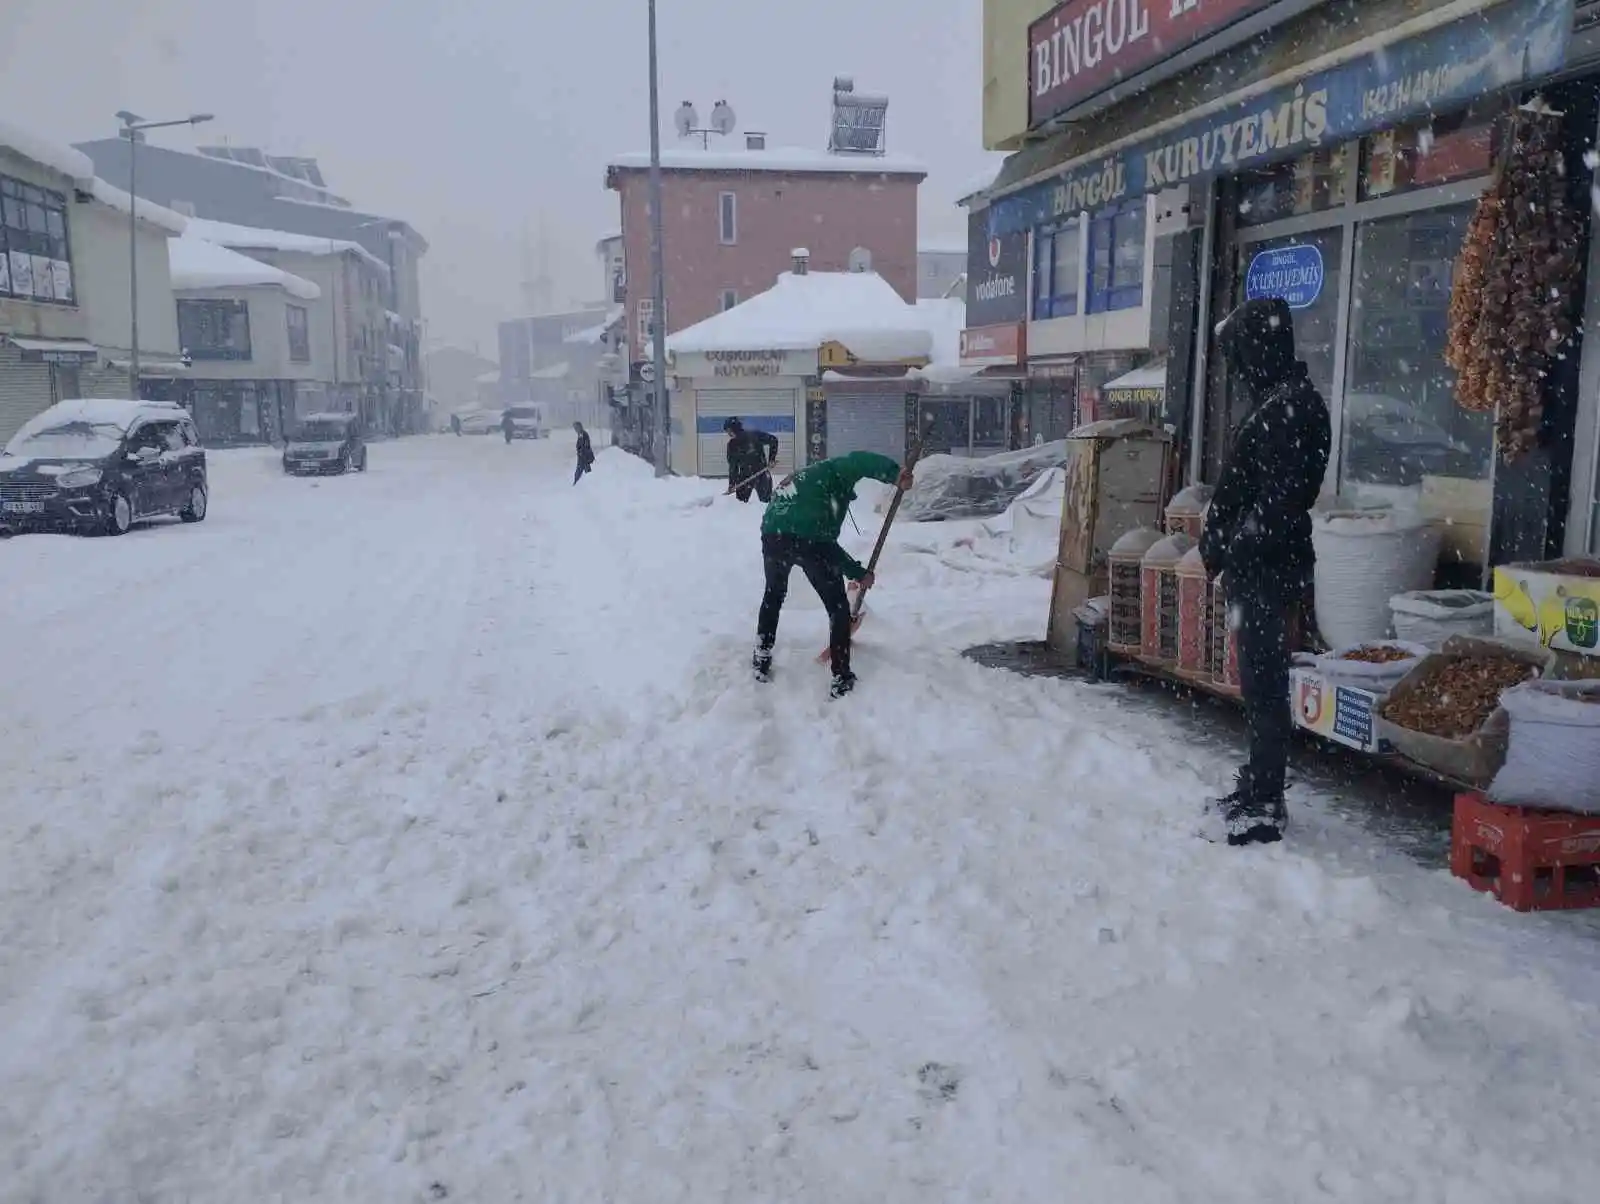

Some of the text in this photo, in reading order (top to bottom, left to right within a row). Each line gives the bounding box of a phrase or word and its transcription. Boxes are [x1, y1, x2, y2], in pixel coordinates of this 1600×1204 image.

[1054, 157, 1127, 216] BİNGÖL
[1144, 82, 1328, 189] KURUYEMİŞ
[975, 271, 1015, 302] vodafone
